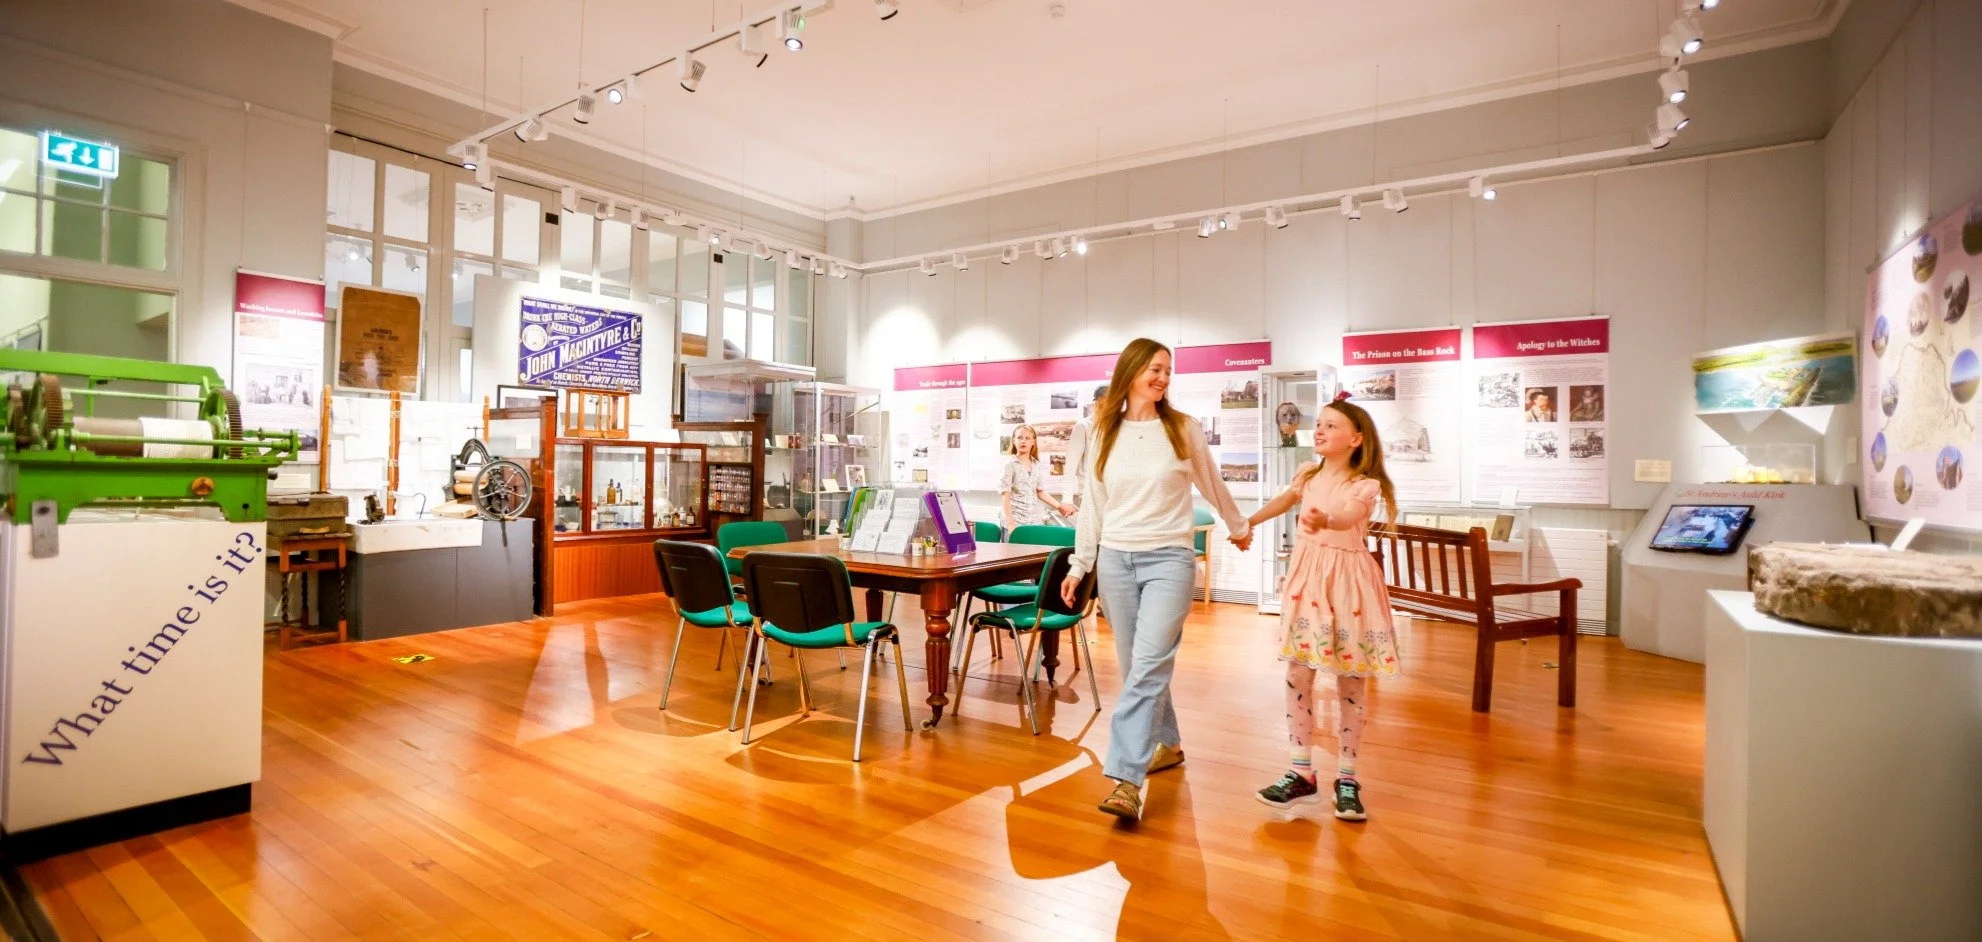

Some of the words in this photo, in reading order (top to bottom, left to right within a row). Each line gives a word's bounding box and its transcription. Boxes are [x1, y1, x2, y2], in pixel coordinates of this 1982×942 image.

[1517, 341, 1546, 351] Apology
[1556, 339, 1568, 348] the
[1569, 337, 1600, 347] Witches
[520, 350, 556, 381] JOHN
[560, 326, 622, 368] MACINTYRE
[623, 327, 630, 341] &
[1352, 351, 1366, 360] The
[1367, 349, 1391, 359] Prison
[1392, 350, 1402, 358] on
[1403, 348, 1416, 357] the
[1417, 348, 1434, 356] Bass
[1436, 346, 1455, 355] Rock
[1225, 358, 1265, 367] Covenanters
[588, 374, 611, 385] NORTH
[1763, 490, 1785, 498] Kirk
[21, 678, 133, 766] What
[121, 606, 201, 675] time
[187, 575, 228, 604] is
[215, 532, 262, 575] it?
